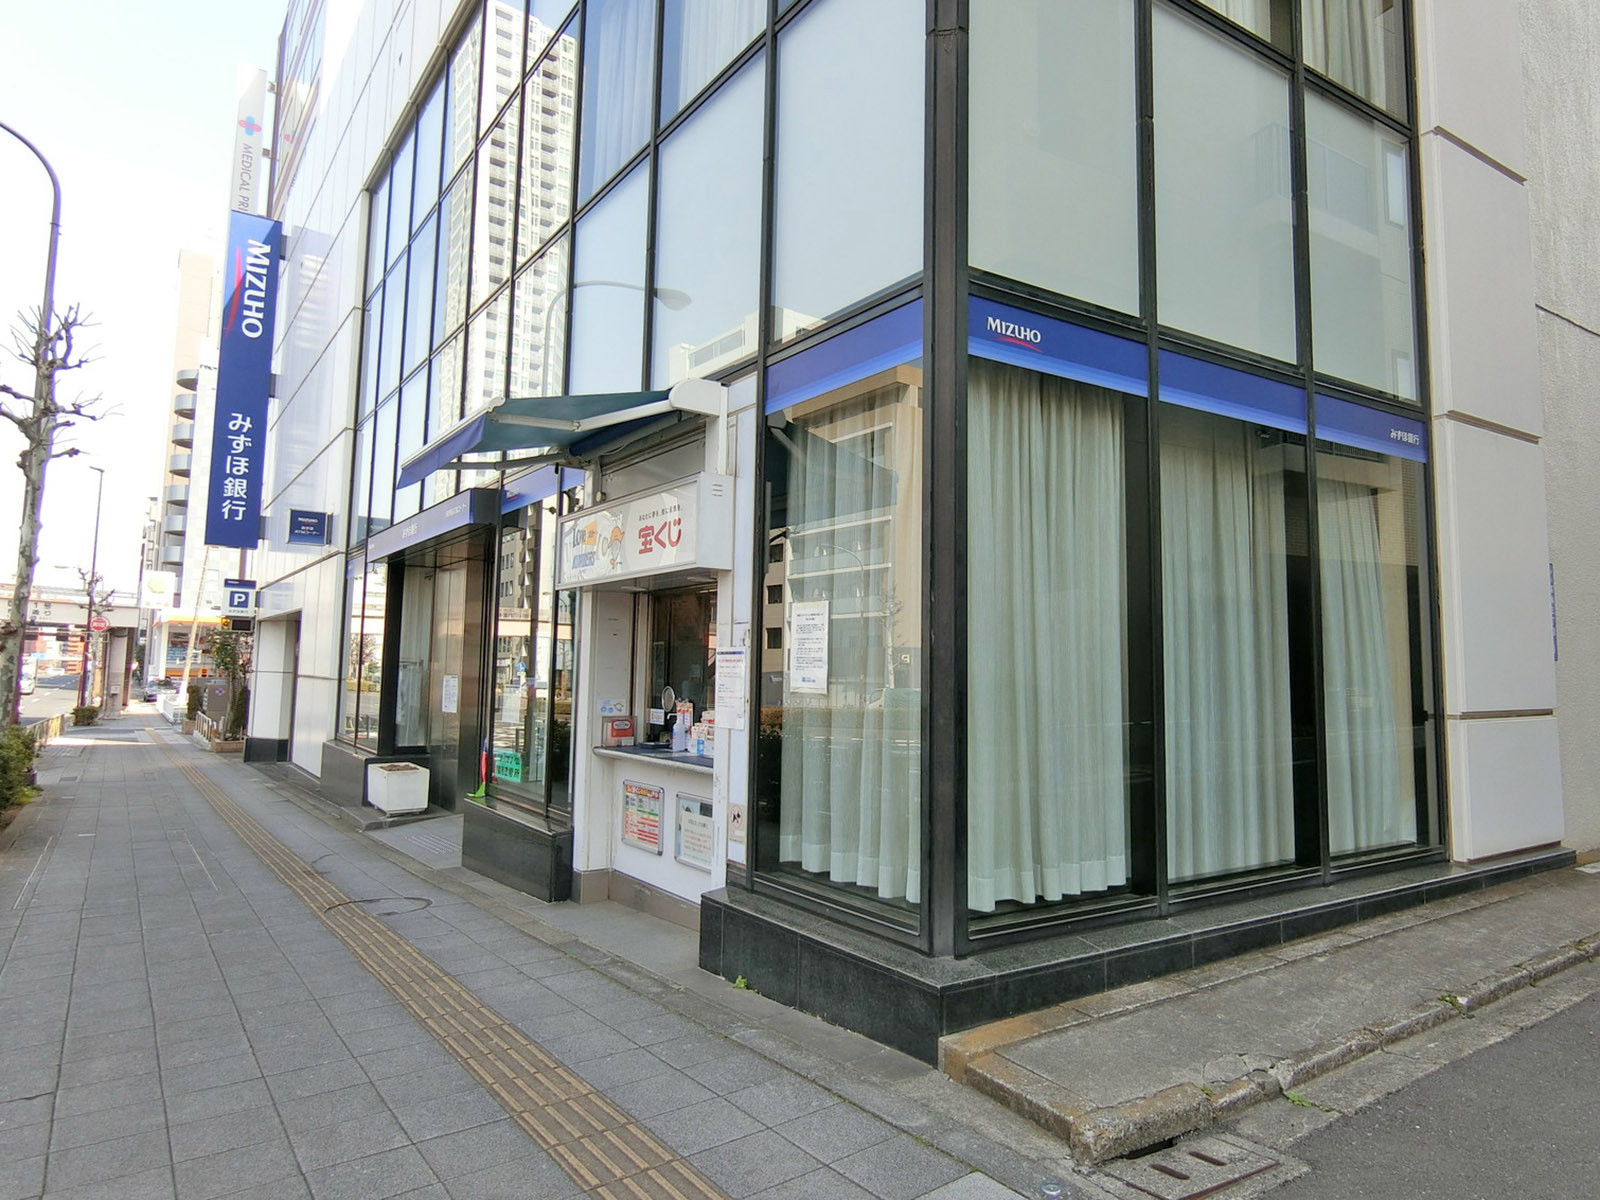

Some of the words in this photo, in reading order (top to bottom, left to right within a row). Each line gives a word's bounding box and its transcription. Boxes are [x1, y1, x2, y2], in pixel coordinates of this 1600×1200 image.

[239, 143, 253, 191] MEDICAL
[242, 239, 271, 338] MIZUHO
[987, 316, 1041, 343] MIZUHO
[222, 413, 252, 520] みずほ銀行
[638, 517, 681, 554] 宝くじ
[234, 593, 246, 606] P
